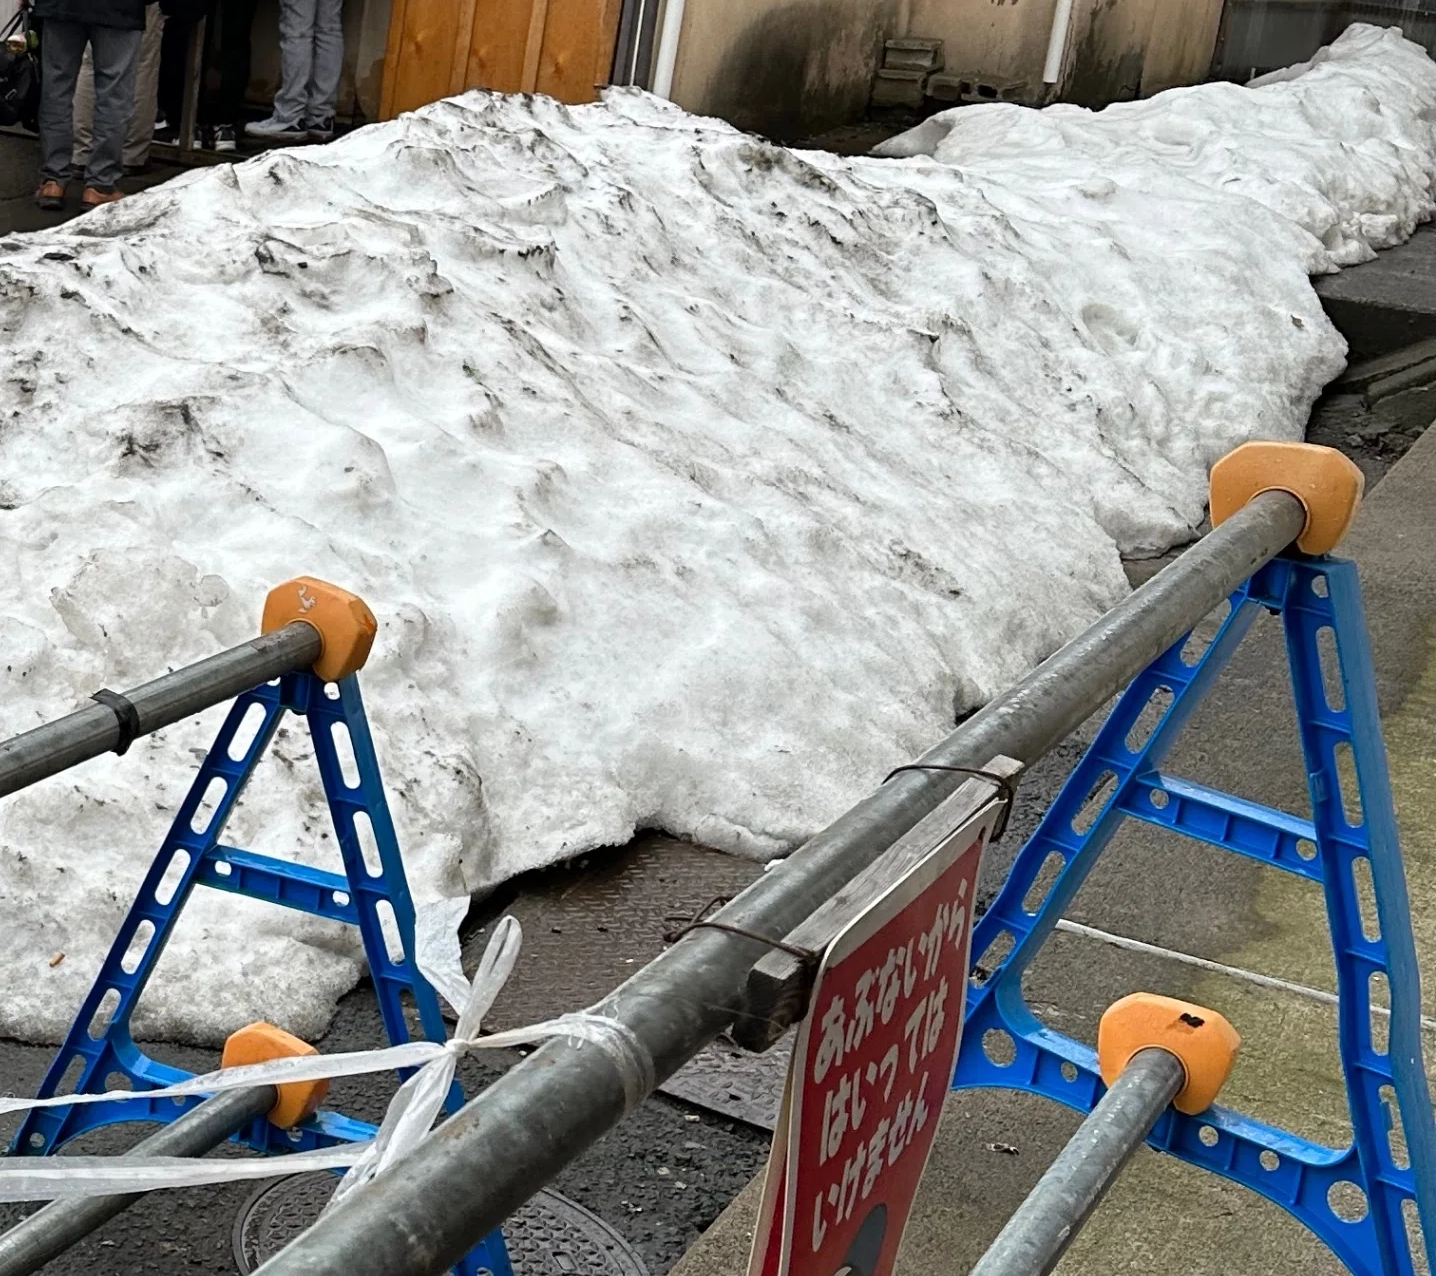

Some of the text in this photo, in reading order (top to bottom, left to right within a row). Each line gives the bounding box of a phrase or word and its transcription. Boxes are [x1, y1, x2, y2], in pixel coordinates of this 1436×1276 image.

[814, 877, 968, 1084] あぶないから
[812, 1071, 929, 1252] いけません
